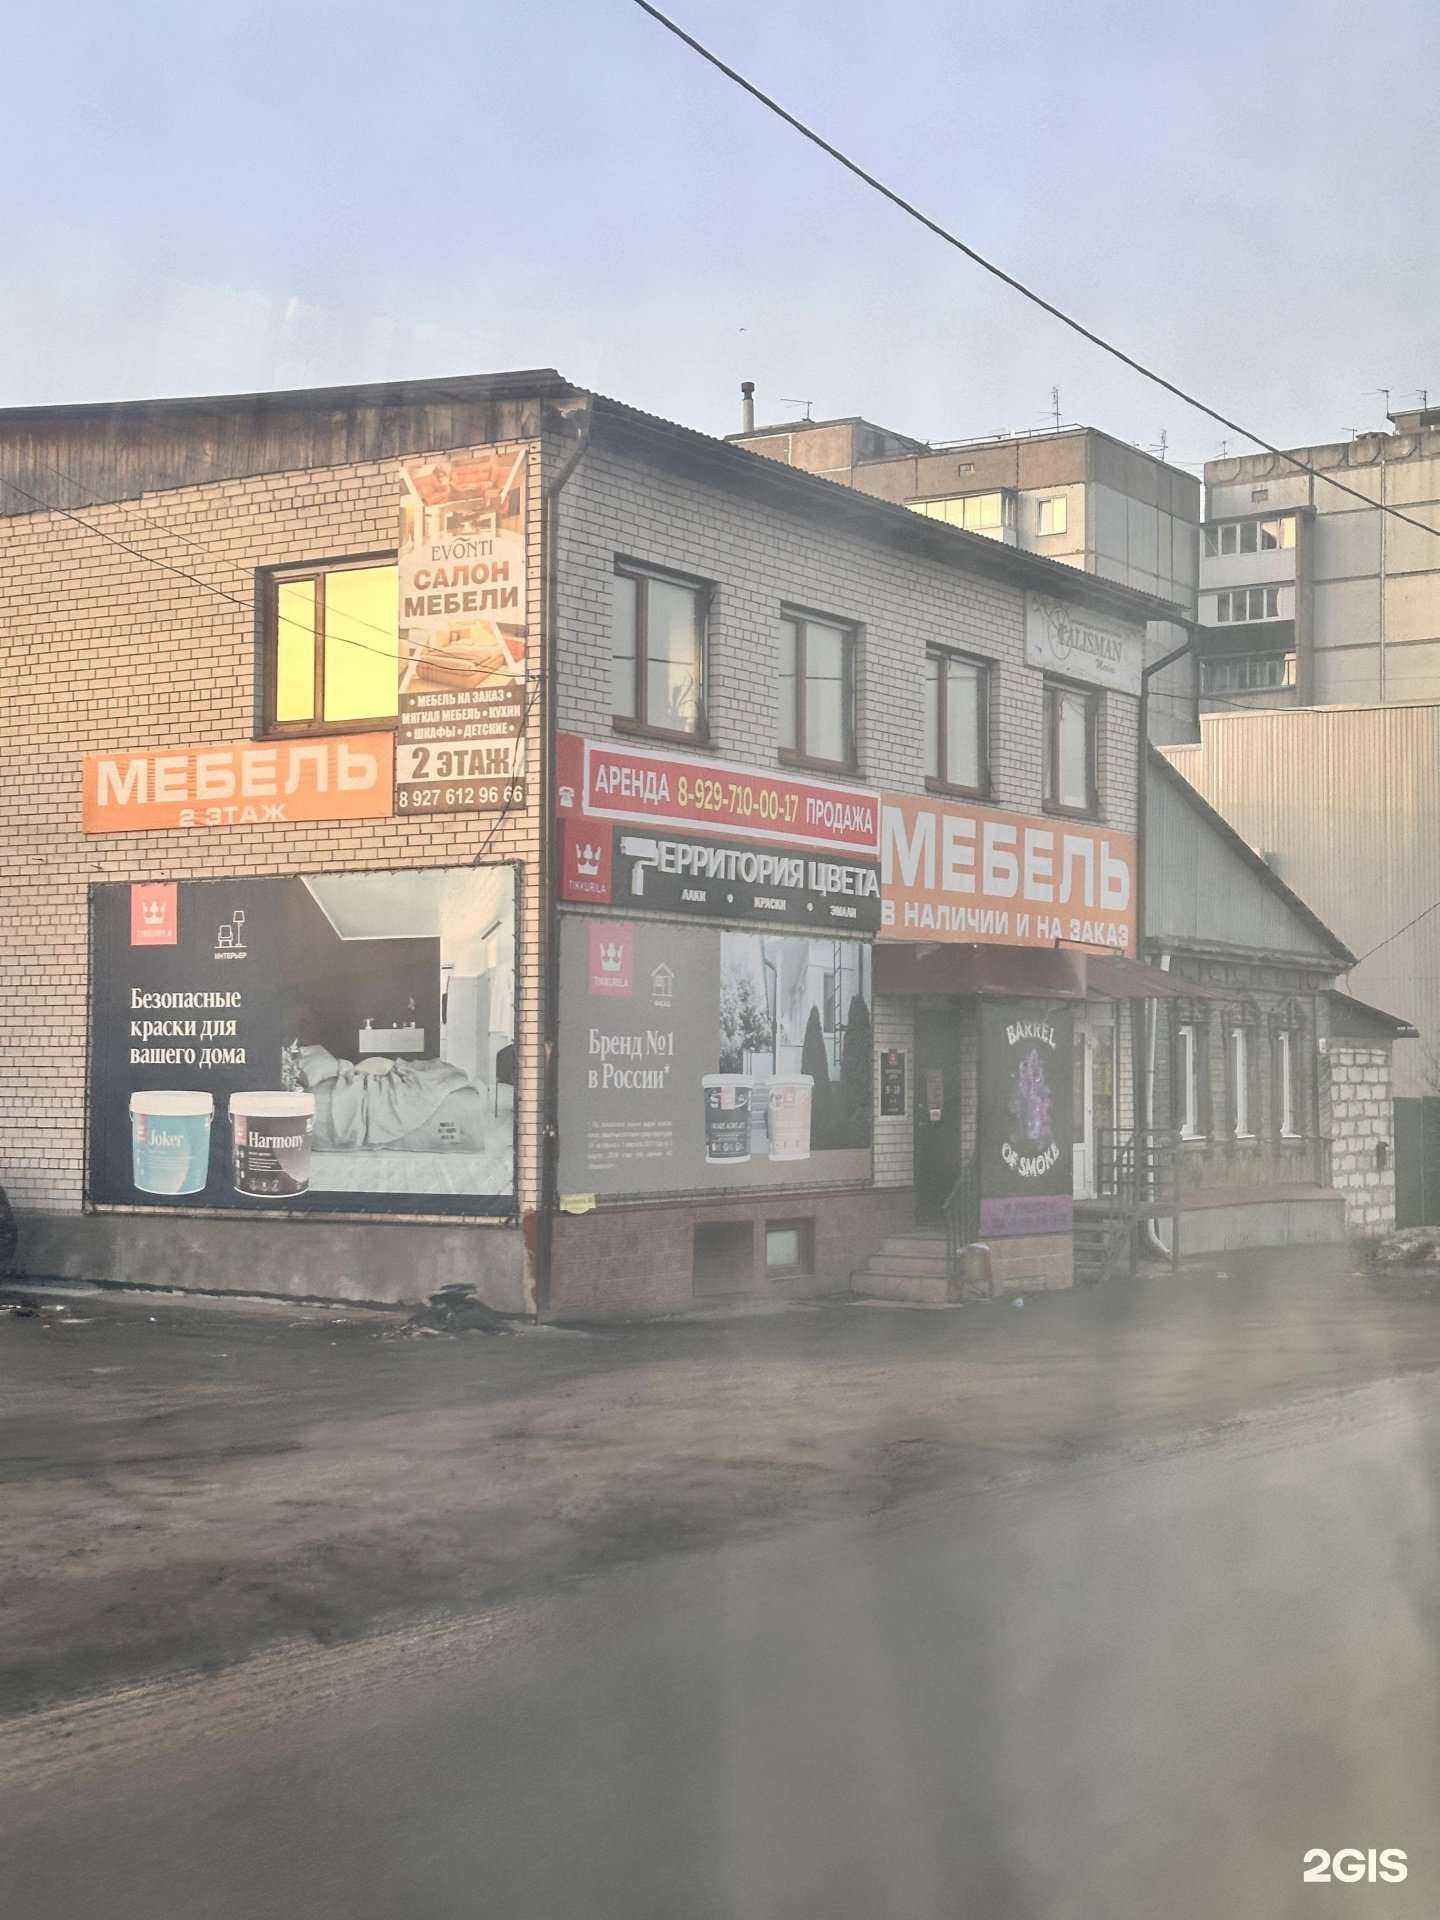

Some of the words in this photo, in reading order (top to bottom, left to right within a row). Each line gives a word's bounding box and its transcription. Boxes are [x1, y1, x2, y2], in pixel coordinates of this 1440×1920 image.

[414, 560, 510, 591] САЛОН
[404, 586, 519, 618] МЕБЕЛИ
[417, 693, 456, 708] МЕБЕЛЬ
[457, 691, 471, 704] НА
[472, 689, 505, 702] ЗАКАЗ
[402, 710, 441, 725] МЯГКАЯ
[442, 707, 481, 721] МЕБЕЛЬ
[489, 705, 521, 718] КУХНИ
[414, 726, 456, 740] ШКАФЫ
[464, 722, 508, 738] ДЕТСКИЕ
[411, 747, 431, 779] 2
[436, 747, 510, 778] ЭТАЖ
[97, 744, 378, 806] МЕБЕЛЬ
[399, 791, 409, 808] 8
[412, 789, 442, 807] 927
[445, 788, 475, 805] 612
[478, 786, 499, 804] 96
[503, 785, 523, 803] 66
[595, 764, 671, 805] АРЕНДА
[677, 775, 799, 823] 8-929-710-00-17
[806, 797, 873, 834] ПРОДАЖА
[179, 808, 195, 827] 2
[205, 803, 287, 825] ЭТАЖ
[881, 804, 1130, 912] МЕБЕЛЬ
[808, 861, 881, 899] ЦВЕТА
[754, 897, 786, 911] КРАСКИ
[881, 900, 895, 926] В
[904, 901, 1008, 936] НАЛИЧИИ
[1017, 913, 1029, 938] И
[1037, 914, 1063, 940] НА
[1070, 918, 1129, 948] ЗАКАЗ
[130, 987, 242, 1009] Безопасные
[130, 1019, 196, 1041] краски
[200, 1020, 237, 1040] для
[1006, 1021, 1057, 1049] BARREL
[588, 1028, 643, 1062] Бренд
[646, 1030, 674, 1056] №1
[130, 1048, 195, 1065] вашего
[199, 1048, 246, 1069] дома
[588, 1069, 598, 1089] в
[149, 1131, 184, 1147] Joker
[249, 1132, 303, 1150] Harmony
